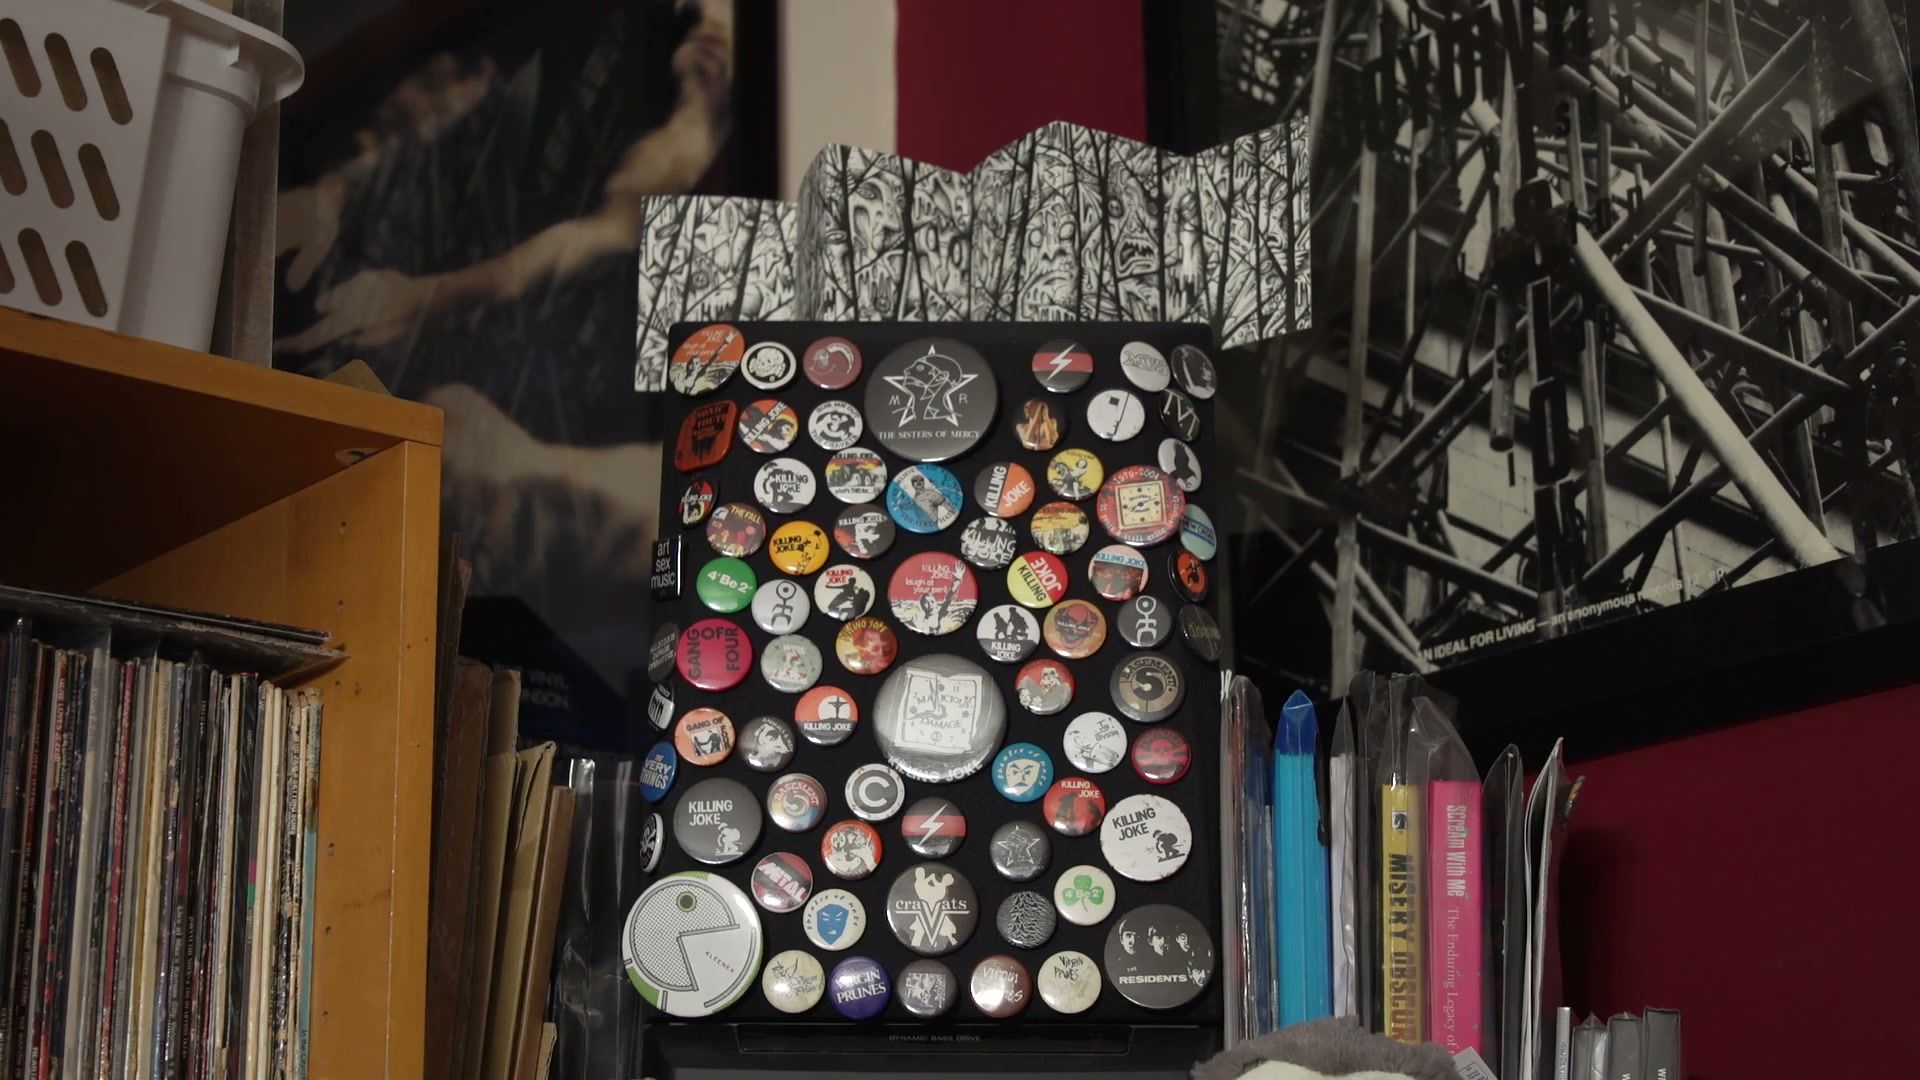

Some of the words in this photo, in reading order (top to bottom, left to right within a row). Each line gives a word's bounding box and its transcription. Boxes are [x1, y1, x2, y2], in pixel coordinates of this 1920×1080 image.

[889, 395, 900, 406] M
[958, 393, 968, 404] R
[743, 416, 770, 445] KILLING
[768, 400, 788, 420] JOKE
[879, 431, 895, 441] THE
[898, 430, 932, 440] SISTERS
[935, 430, 948, 439] OF
[950, 430, 980, 440] MERCY
[775, 471, 809, 484] KILLING
[777, 482, 801, 493] JOKE
[984, 465, 1007, 509] KILLING
[1003, 480, 1032, 508] JOKE
[730, 504, 744, 517] THE
[742, 511, 761, 525] FALL
[838, 515, 864, 526] KILLING
[656, 540, 670, 556] art
[773, 535, 802, 546] KILLING
[774, 544, 796, 554] JOKE
[655, 558, 671, 573] sex
[1095, 552, 1125, 563] KILLING
[825, 568, 854, 577] KILLING
[920, 564, 950, 573] KILLING
[931, 572, 950, 580] JOKE
[1030, 557, 1063, 591] JOKE
[650, 571, 676, 590] music
[828, 576, 846, 585] JOKE
[905, 577, 926, 587] laugh
[1018, 564, 1047, 602] KILLING
[913, 586, 931, 594] your
[1434, 637, 1470, 661] IDEAL
[1469, 629, 1496, 649] FOR
[1495, 617, 1537, 642] LIVING
[1567, 592, 1636, 622] anonymous
[686, 627, 702, 680] GANG
[701, 627, 726, 641] OF
[725, 627, 740, 672] FOUR
[991, 640, 1022, 653] KILLING
[996, 650, 1016, 660] JOKE
[1121, 657, 1177, 689] BASEMENT
[57, 677, 66, 701] GENE
[917, 694, 973, 709] MAICIOUS
[55, 702, 65, 731] LOVES
[920, 717, 961, 730] DAMAGE
[686, 719, 711, 732] GANG
[711, 715, 725, 725] OF
[719, 725, 730, 751] FOUR
[803, 722, 832, 731] KILLING
[832, 722, 852, 731] JOKE
[645, 759, 673, 775] VERY
[945, 760, 983, 782] JOKE
[640, 768, 669, 790] THINGS
[1061, 780, 1091, 789] KILLING
[774, 781, 820, 806] BASEMENT
[1078, 789, 1100, 799] JOKE
[688, 799, 733, 814] KILLING
[689, 813, 721, 826] JOKE
[1111, 807, 1157, 830] KILLING
[1118, 822, 1150, 841] JOKE
[1446, 851, 1467, 877] With
[758, 862, 807, 903] METAL
[1389, 852, 1416, 942] MISERY
[176, 905, 185, 924] Live
[1446, 906, 1460, 930] The
[175, 926, 184, 937] at
[704, 950, 736, 974] KLEENEX
[1442, 933, 1460, 989] Enduring
[1118, 973, 1189, 985] RESIDENTS
[836, 982, 887, 1004] PRUNES
[170, 1000, 180, 1019] City
[1442, 991, 1460, 1033] Legacy
[889, 1034, 929, 1042] DYNAMIC
[931, 1034, 954, 1042] BASS
[956, 1034, 981, 1042] DRIVE
[1446, 1033, 1461, 1050] of
